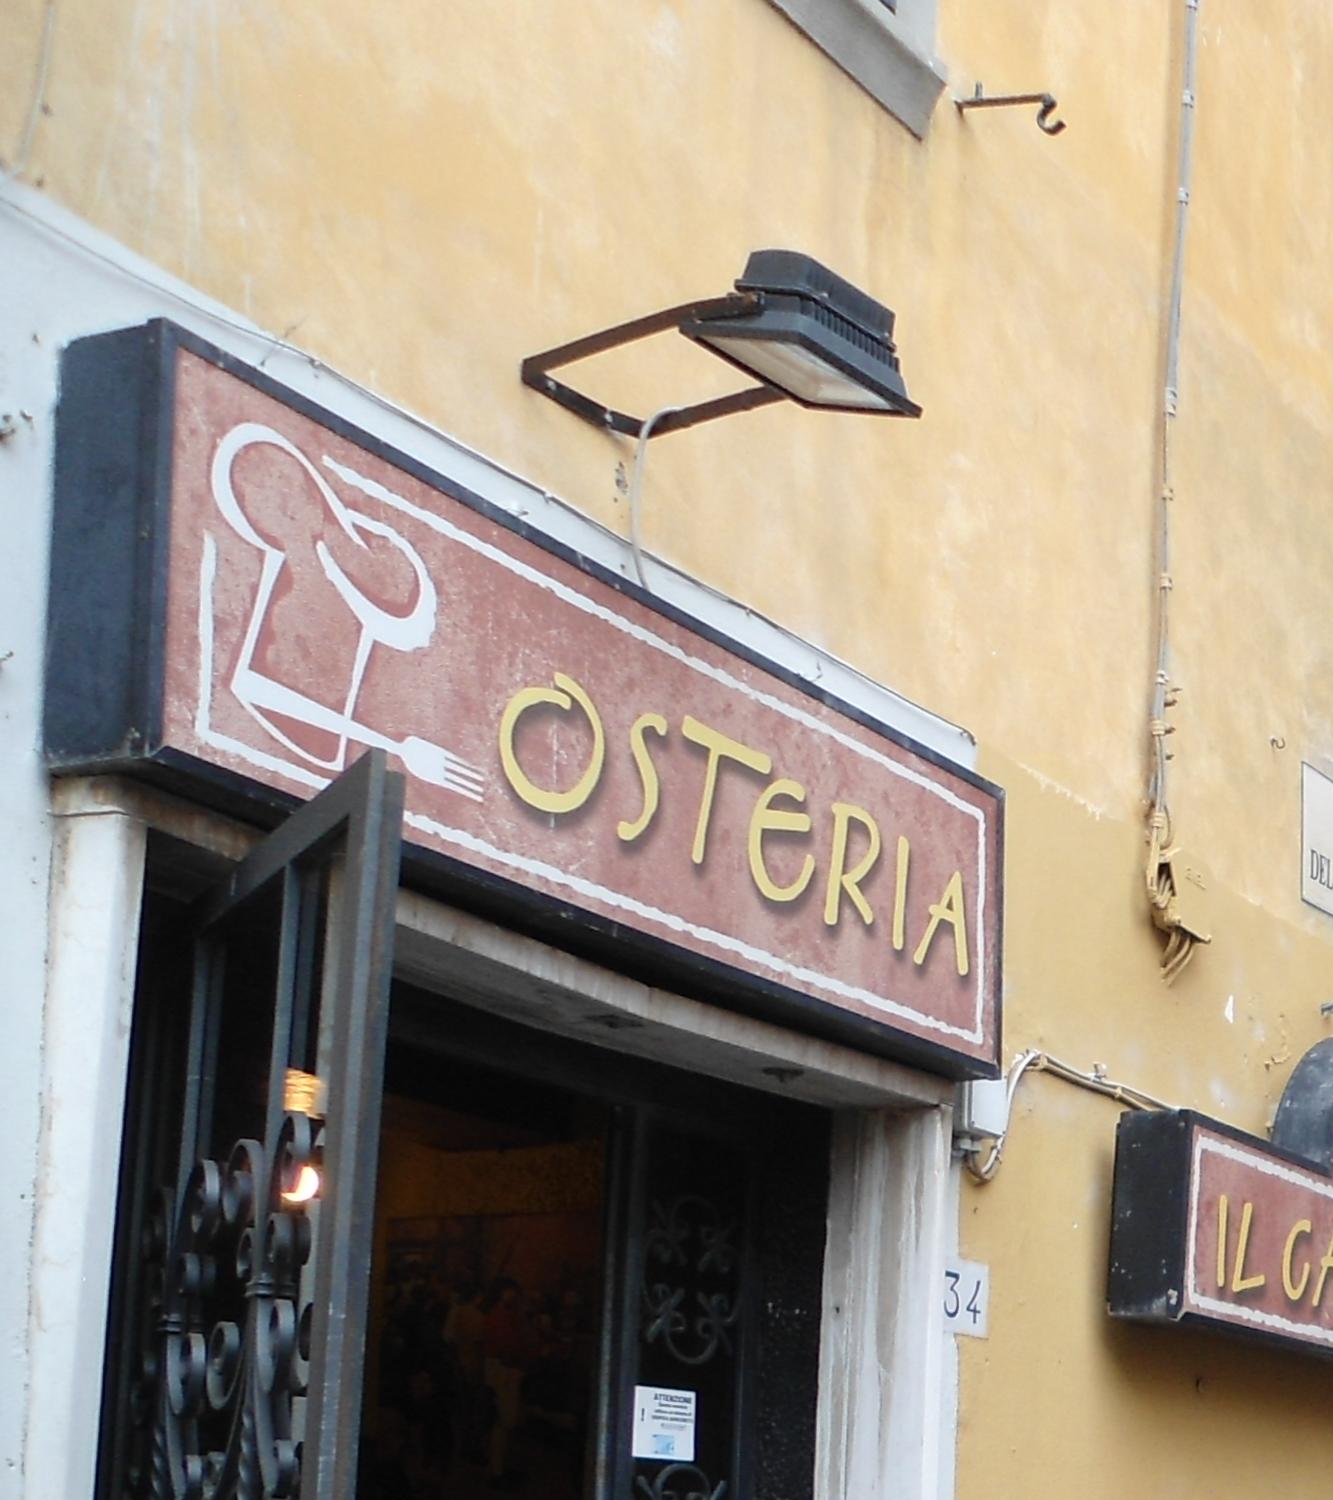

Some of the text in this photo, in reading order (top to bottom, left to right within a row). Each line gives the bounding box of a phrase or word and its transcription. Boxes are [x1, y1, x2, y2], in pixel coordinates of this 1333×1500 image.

[499, 671, 970, 977] OSTERIA
[1310, 848, 1333, 891] DEL
[1216, 1194, 1266, 1293] IL
[943, 1269, 982, 1324] 34
